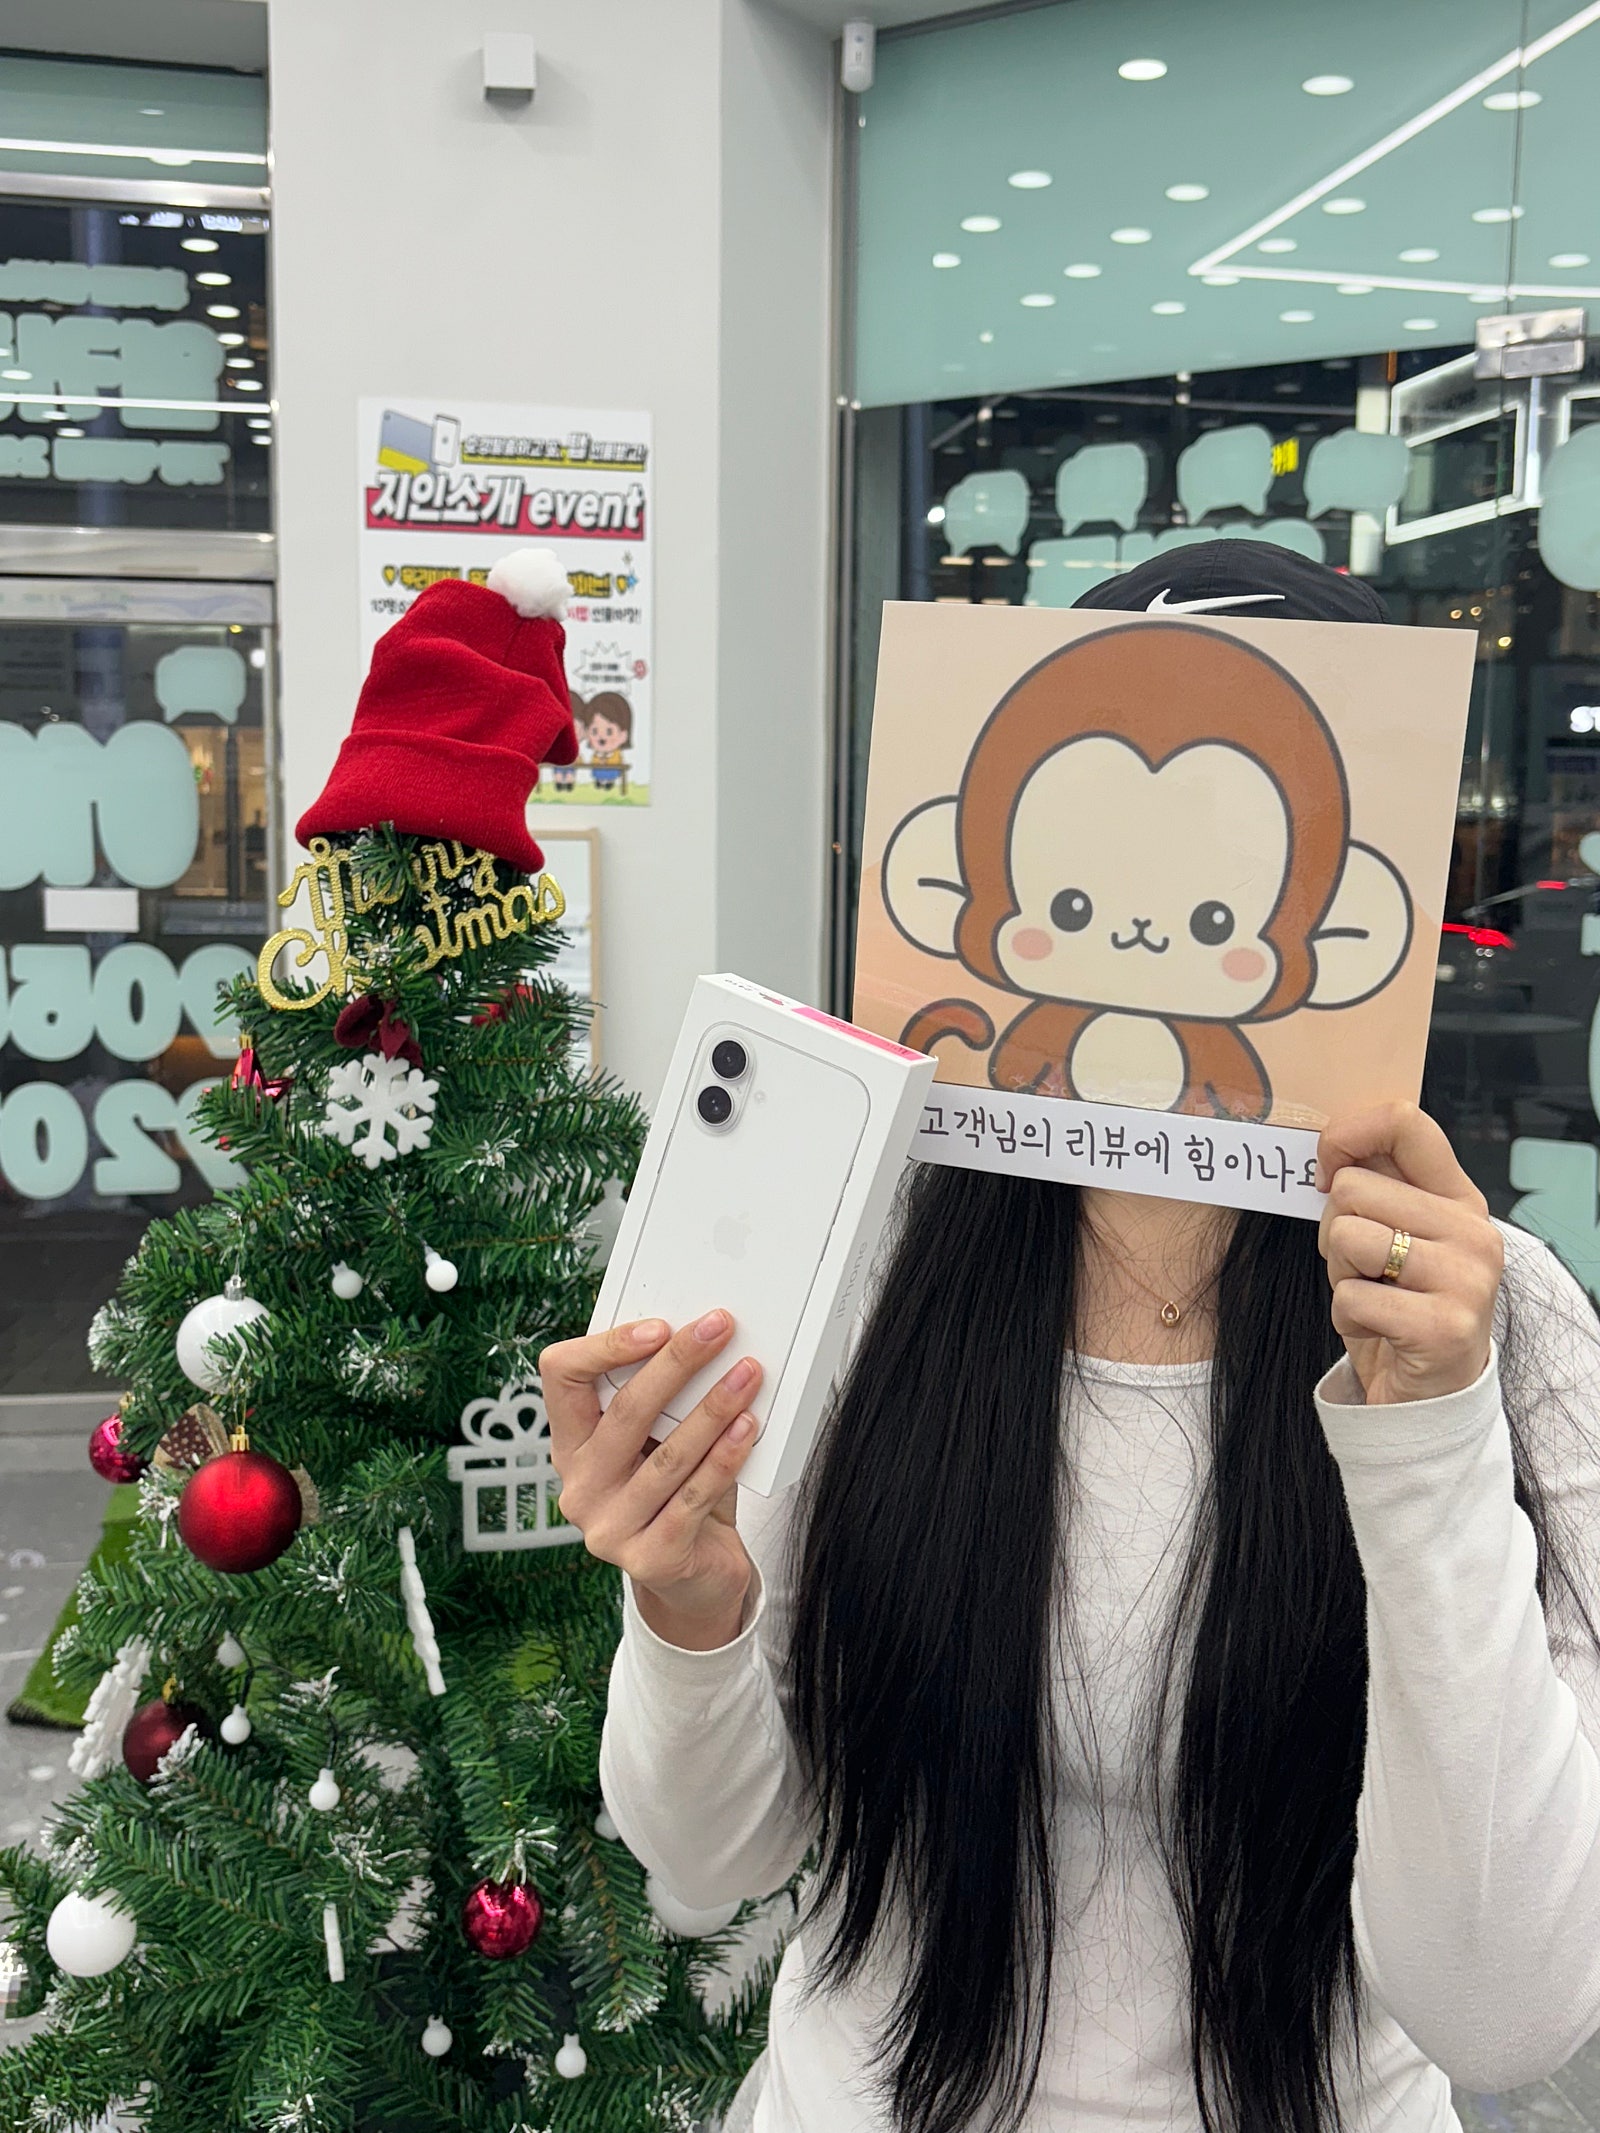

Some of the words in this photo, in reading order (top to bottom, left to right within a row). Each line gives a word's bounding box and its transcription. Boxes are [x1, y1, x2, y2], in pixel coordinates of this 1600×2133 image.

[370, 472, 525, 526] 지인소개
[528, 484, 644, 530] event
[919, 1105, 1051, 1157] 고객님의
[1065, 1120, 1169, 1174] 리뷰에
[835, 1241, 868, 1319] iPhone
